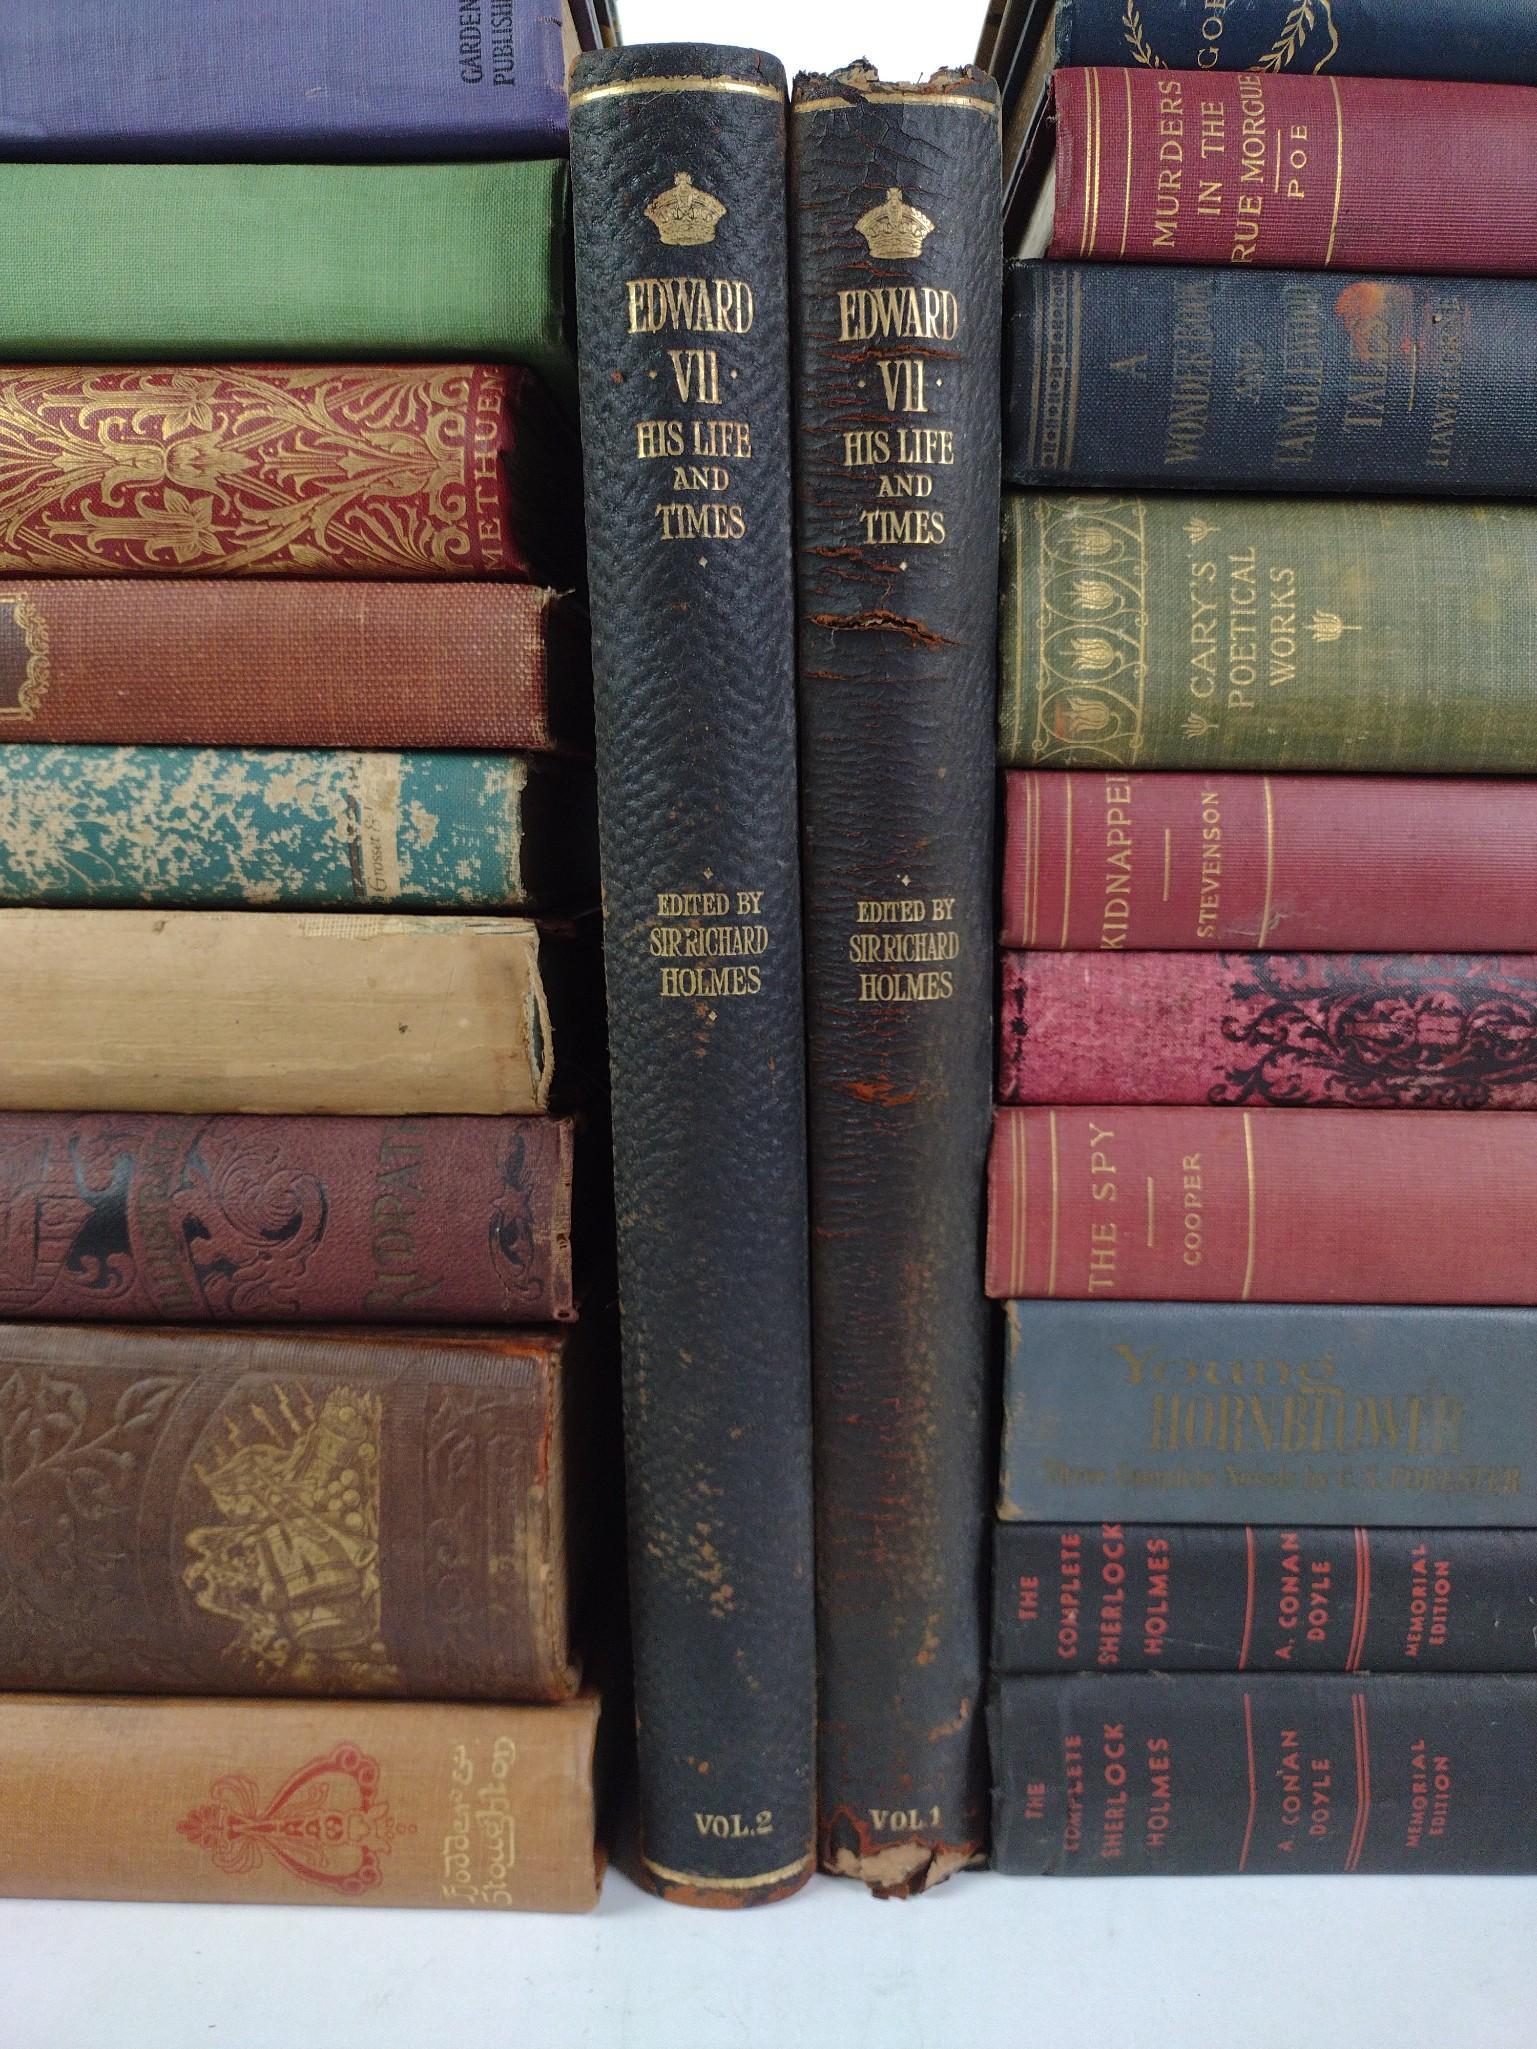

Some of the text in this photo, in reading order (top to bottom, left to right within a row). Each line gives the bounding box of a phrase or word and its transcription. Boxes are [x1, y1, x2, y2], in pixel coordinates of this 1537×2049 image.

[1152, 79, 1185, 249] MURDERS
[1197, 98, 1227, 216] IN THE
[1230, 74, 1267, 264] RUE MORGUE
[1287, 124, 1309, 199] POE
[625, 278, 754, 334] EDWARD
[837, 287, 959, 342] EDWARD
[668, 349, 722, 404] VII
[878, 360, 928, 412] VII
[1164, 346, 1214, 464] WONDER
[474, 369, 504, 570] METHUEN
[635, 421, 752, 459] HIS LIFE
[673, 466, 730, 491] AND
[843, 429, 955, 466] HIS LIFE
[655, 503, 746, 540] TIMES
[877, 474, 933, 498] AND
[861, 510, 946, 545] TIMES
[1190, 554, 1217, 698] CARY'S
[1227, 547, 1256, 710] POETICAL
[1269, 566, 1296, 688] WORKS
[657, 891, 764, 916] EDITED BY
[1197, 791, 1221, 938] STEVENSON
[650, 925, 769, 957] SIR RICHARD
[850, 931, 960, 963] SIR RICHARD
[856, 898, 955, 923] EDITED BY
[659, 966, 762, 997] HOLMES
[858, 971, 953, 1002] HOLMES
[1088, 1122, 1118, 1293] THE SPY
[1183, 1152, 1202, 1266] COOPER
[1112, 1343, 1345, 1397] Young
[1150, 1391, 1467, 1455] HORNBLOWER
[1018, 1576, 1040, 1620] THE
[1058, 1533, 1082, 1660] COMPLETE
[1098, 1524, 1126, 1665] SHERLOCK
[1143, 1538, 1170, 1656] HOLMES
[1278, 1532, 1300, 1629] CONAN
[1306, 1561, 1331, 1641] DOYLE
[1405, 1543, 1428, 1657] MEMORIAL
[1428, 1561, 1451, 1646] EDITION
[1024, 1782, 1046, 1819] THE
[1063, 1734, 1084, 1853] COMPLETE
[1100, 1723, 1128, 1857] SHERLOCK
[1146, 1738, 1173, 1847] HOLMES
[1280, 1729, 1301, 1826] CONAN
[1309, 1759, 1331, 1836] DOYLE
[1405, 1738, 1428, 1848] MEMORIAL
[1428, 1756, 1451, 1836] EDITION
